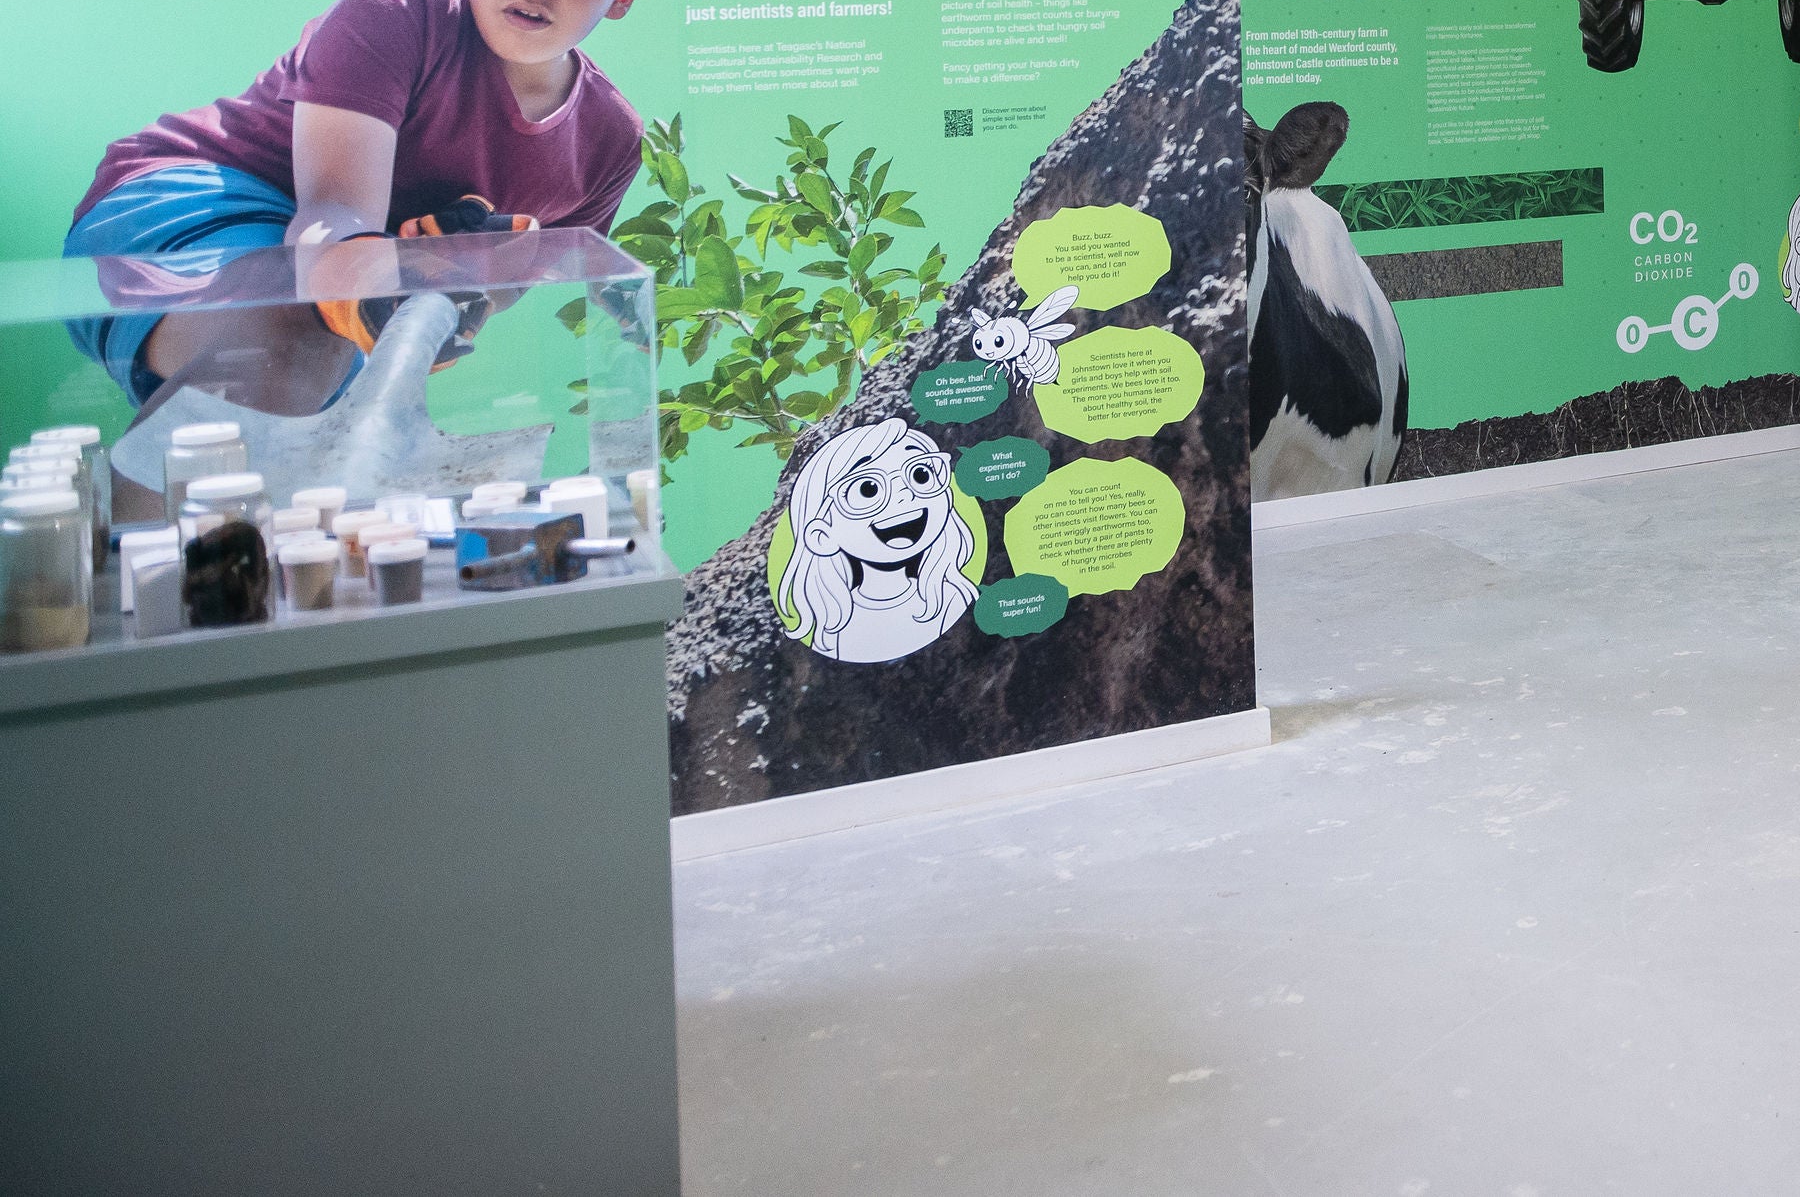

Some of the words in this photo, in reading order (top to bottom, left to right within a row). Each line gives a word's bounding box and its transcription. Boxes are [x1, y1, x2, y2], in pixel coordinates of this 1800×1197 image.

[686, 5, 715, 24] just
[719, 3, 793, 19] scientists
[797, 2, 825, 17] and
[829, 0, 891, 16] farmers!
[1246, 30, 1268, 40] From
[1271, 29, 1298, 39] model
[1358, 27, 1377, 37] farm
[1380, 27, 1387, 36] in
[1246, 45, 1260, 55] the
[1262, 45, 1286, 54] heart
[1288, 43, 1297, 53] of
[1299, 43, 1326, 53] model
[1328, 42, 1364, 52] Wexford
[1366, 42, 1396, 53] county,
[943, 63, 970, 72] Fancy
[973, 62, 1004, 72] getting
[1007, 62, 1026, 71] your
[1030, 59, 1057, 68] hands
[1059, 58, 1079, 68] dirty
[1246, 59, 1293, 70] Johnstown
[1296, 57, 1322, 68] Castle
[1325, 56, 1367, 67] continues
[1370, 57, 1378, 65] to
[1380, 55, 1391, 65] be
[1246, 74, 1263, 84] role
[1266, 73, 1293, 83] model
[1295, 72, 1321, 84] today.
[1071, 243, 1086, 251] said
[1103, 240, 1130, 248] wanted
[1073, 252, 1105, 260] scientist,
[1634, 252, 1692, 266] CARBON
[1060, 266, 1073, 274] you
[1093, 261, 1106, 269] and
[1635, 267, 1693, 282] DIOXIDE
[1683, 306, 1708, 338] C
[968, 373, 985, 382] that
[925, 387, 953, 397] sounds
[955, 384, 994, 393] awesome.
[934, 398, 947, 406] Tell
[992, 452, 1012, 460] What
[979, 460, 1025, 472] experiments
[1006, 470, 1020, 478] do?
[998, 599, 1015, 607] That
[1017, 594, 1044, 604] sounds
[1002, 608, 1024, 617] super
[1026, 604, 1040, 613] fun!
